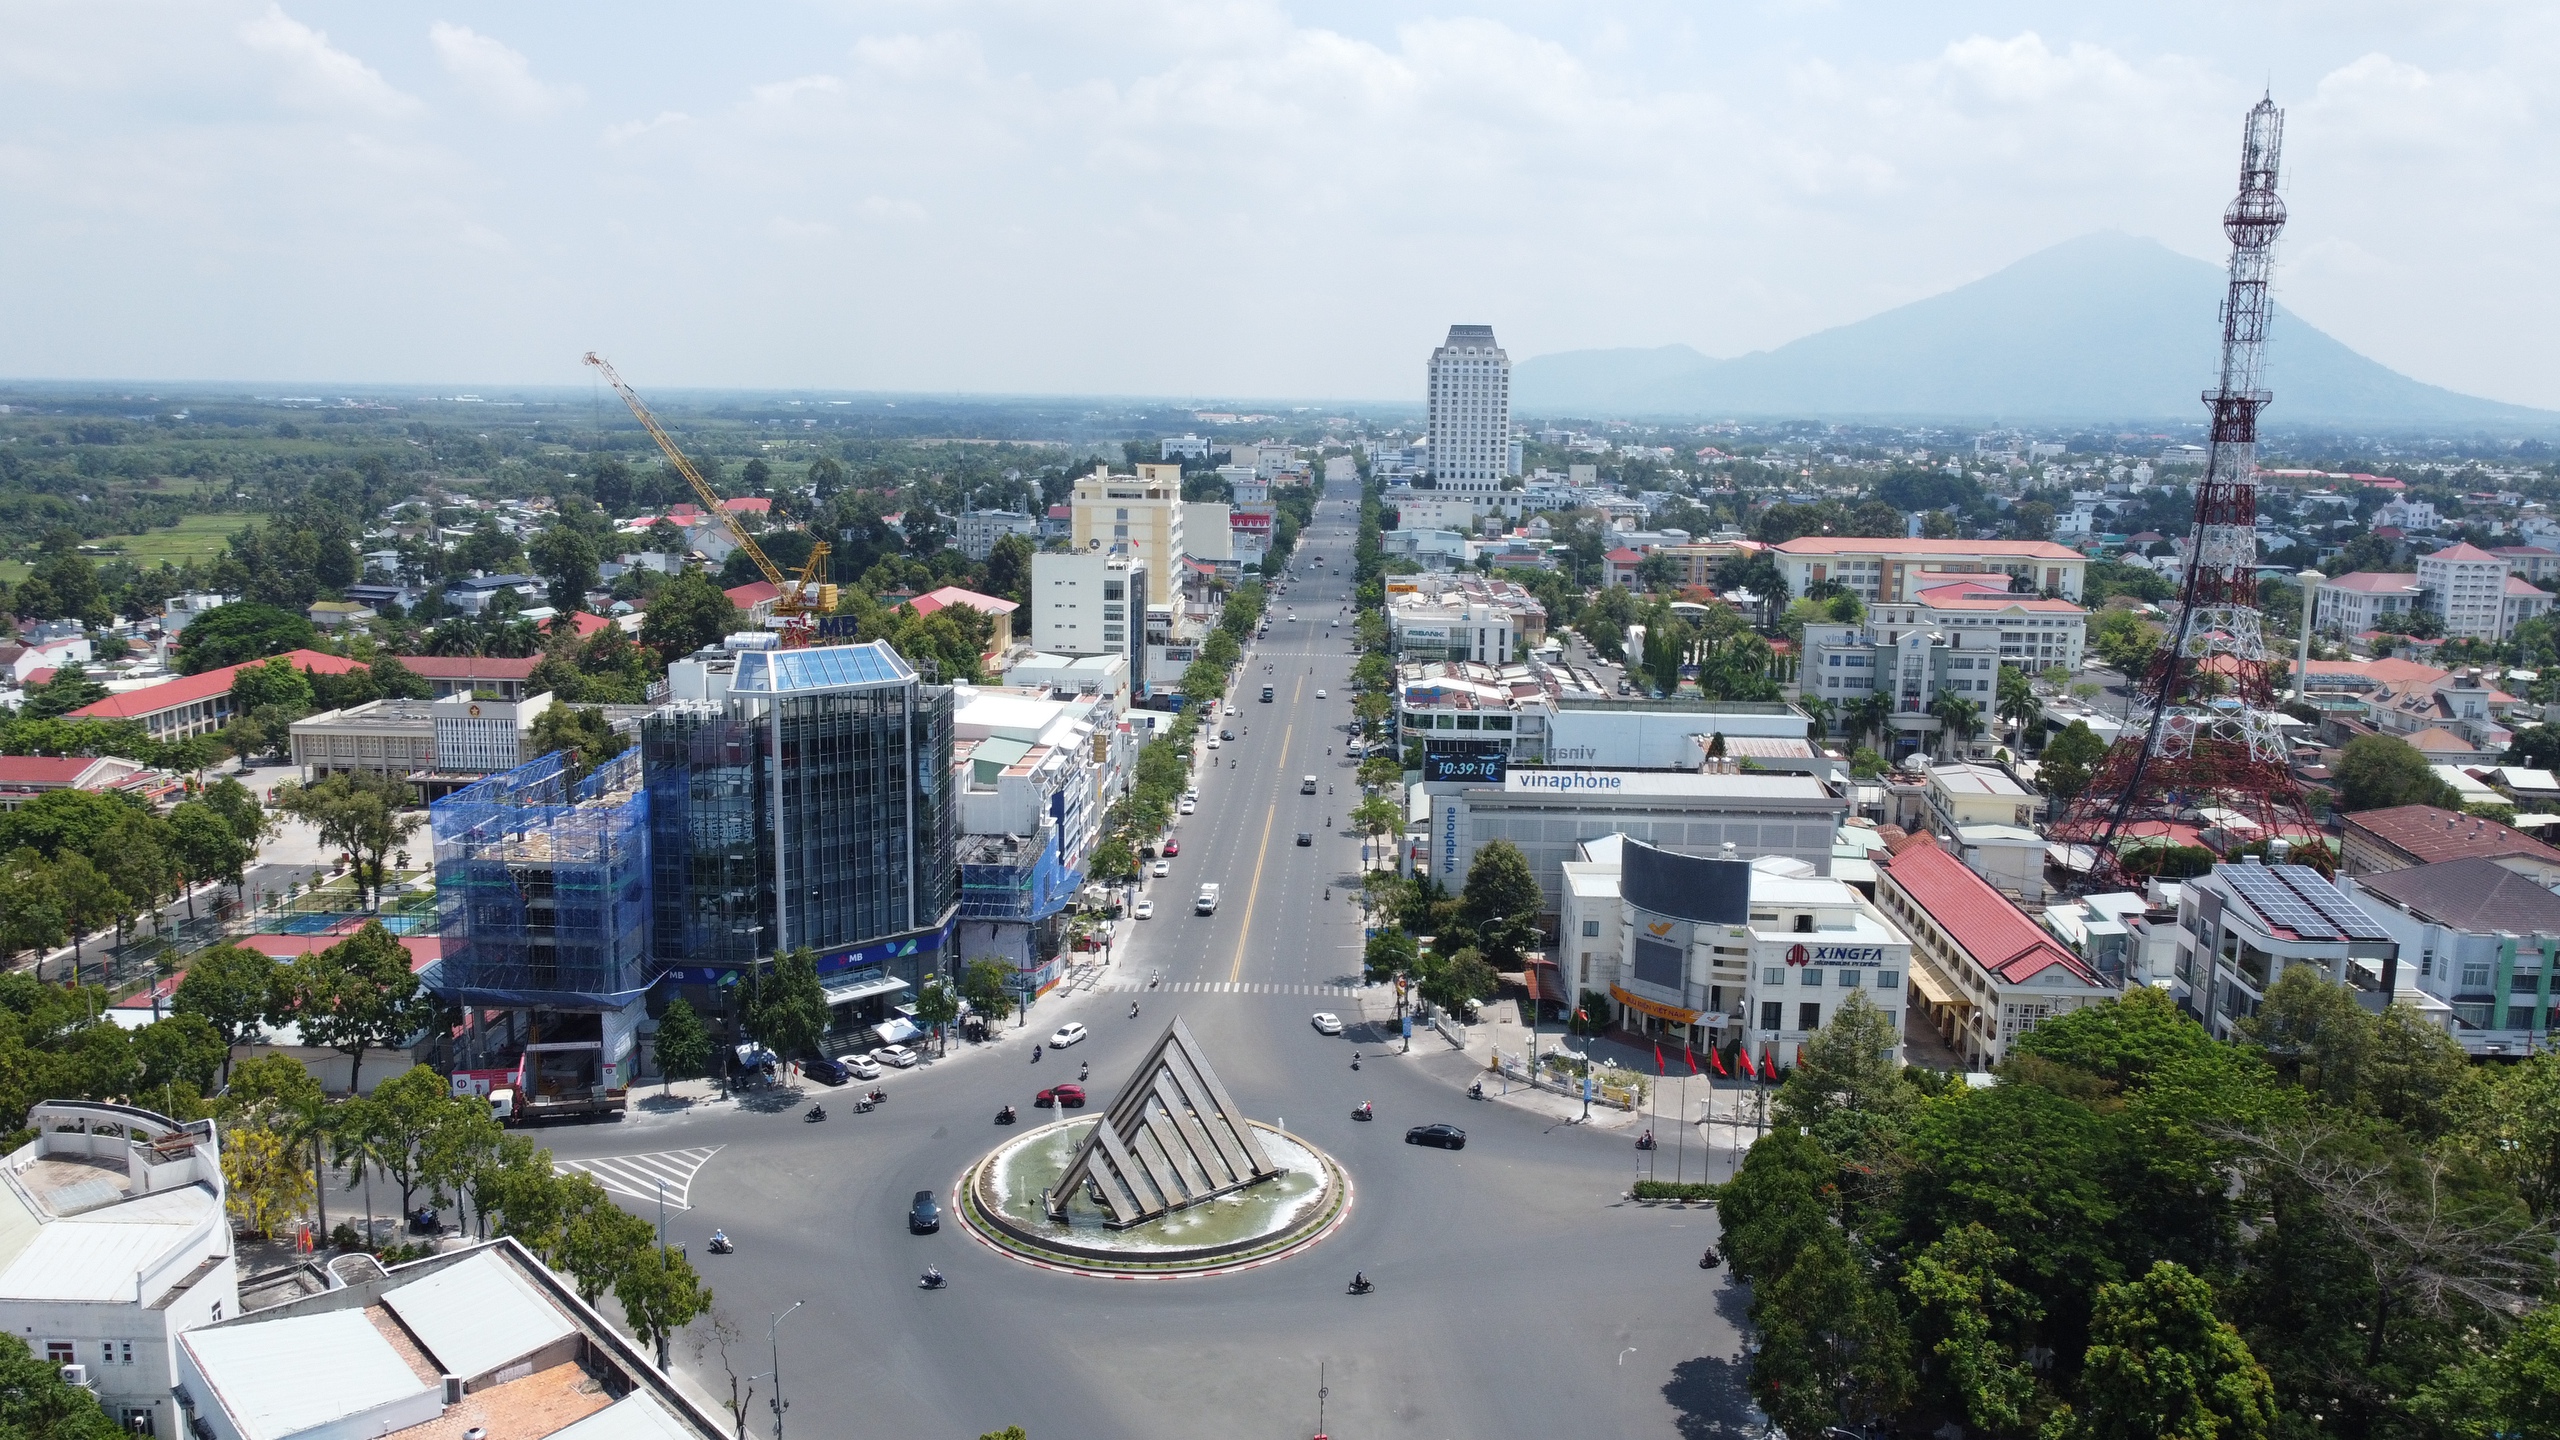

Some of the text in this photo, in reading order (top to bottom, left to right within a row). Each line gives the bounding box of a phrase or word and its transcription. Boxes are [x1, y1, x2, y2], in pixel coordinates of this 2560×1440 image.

[820, 615, 858, 638] MB
[1407, 630, 1445, 638] ABBANK
[1439, 761, 1495, 776] 10:39:10
[1519, 770, 1622, 791] vinaphone
[1443, 806, 1456, 874] vinaphone
[849, 952, 863, 963] MB
[1814, 946, 1882, 960] XINGFA
[669, 970, 684, 980] MB
[1668, 1010, 1686, 1019] NAM
